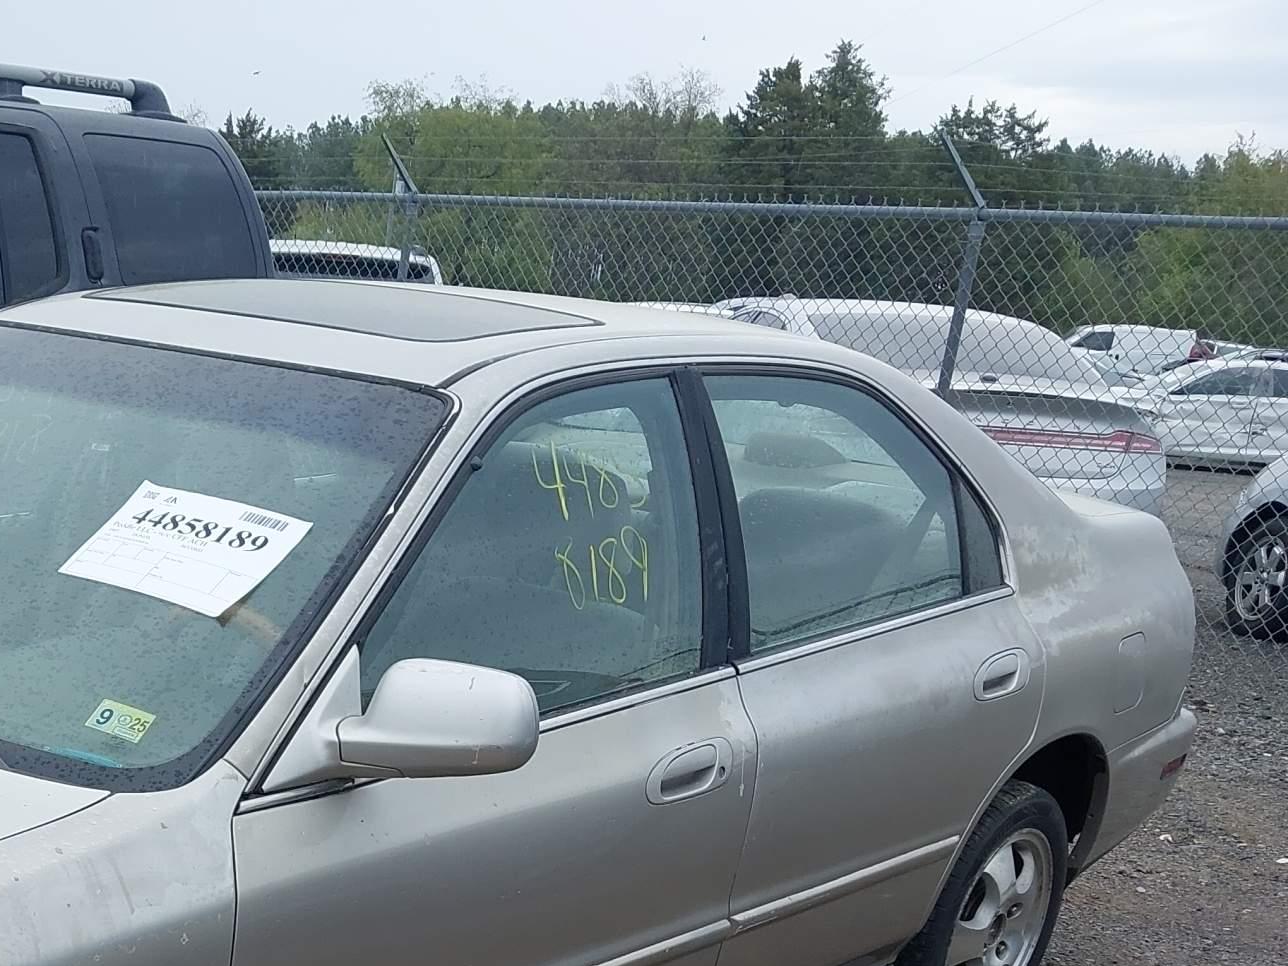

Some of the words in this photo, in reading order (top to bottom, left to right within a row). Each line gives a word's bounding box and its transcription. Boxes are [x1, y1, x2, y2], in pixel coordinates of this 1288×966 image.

[40, 70, 121, 91] XTERRA
[132, 508, 270, 552] 44858189
[554, 525, 649, 610] 8189
[95, 708, 115, 725] 9
[128, 717, 150, 733] 25
